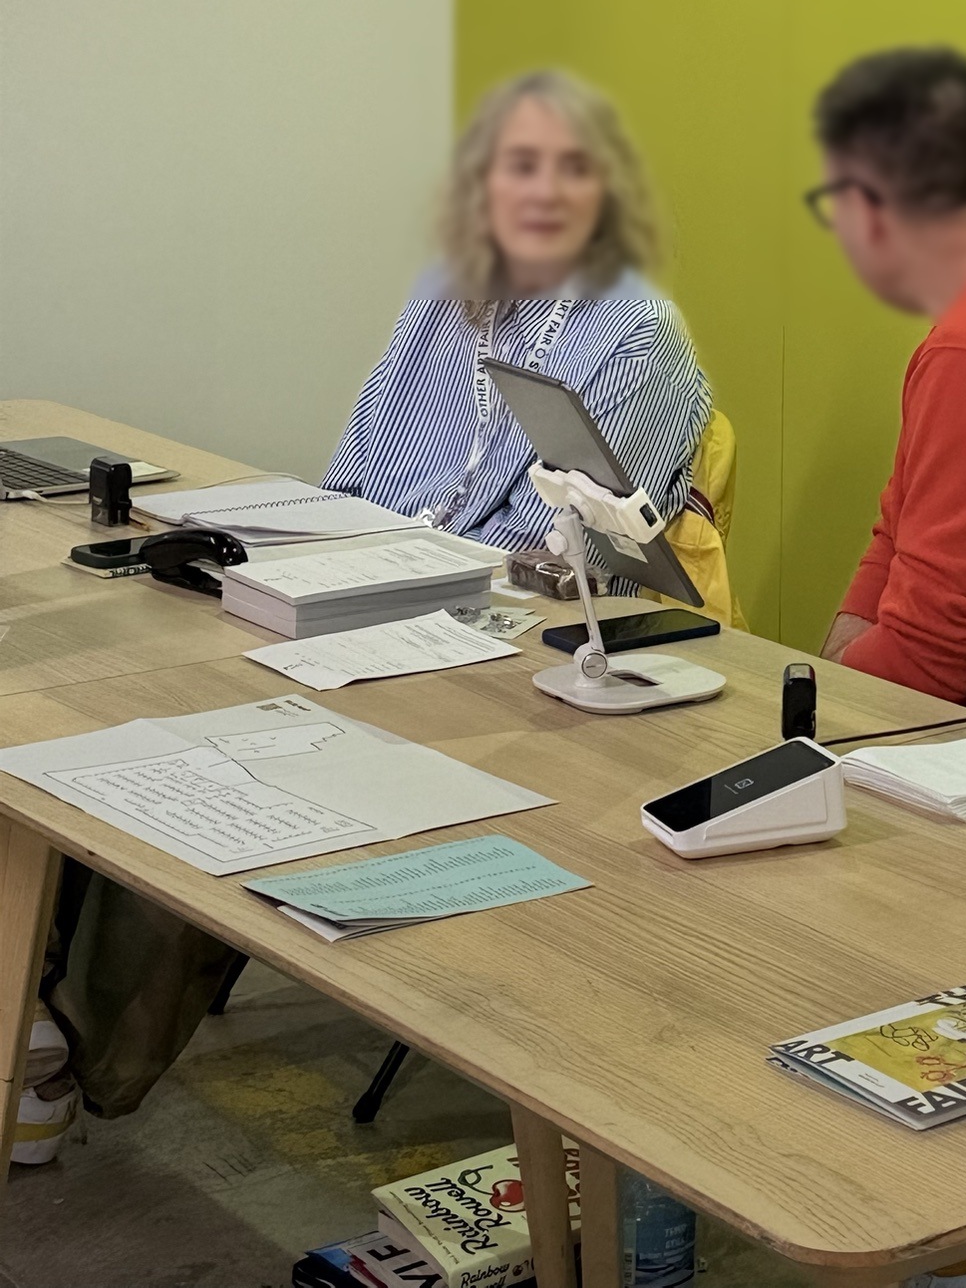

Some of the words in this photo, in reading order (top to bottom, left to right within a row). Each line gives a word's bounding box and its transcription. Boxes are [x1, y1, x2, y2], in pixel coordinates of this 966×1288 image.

[478, 320, 490, 348] FAIR
[539, 320, 560, 346] FAIR
[477, 378, 489, 417] OTHER
[768, 1039, 855, 1068] ART
[425, 1177, 511, 1232] Rowell
[404, 1187, 499, 1255] Rainbow
[461, 1263, 510, 1288] Rainbow
